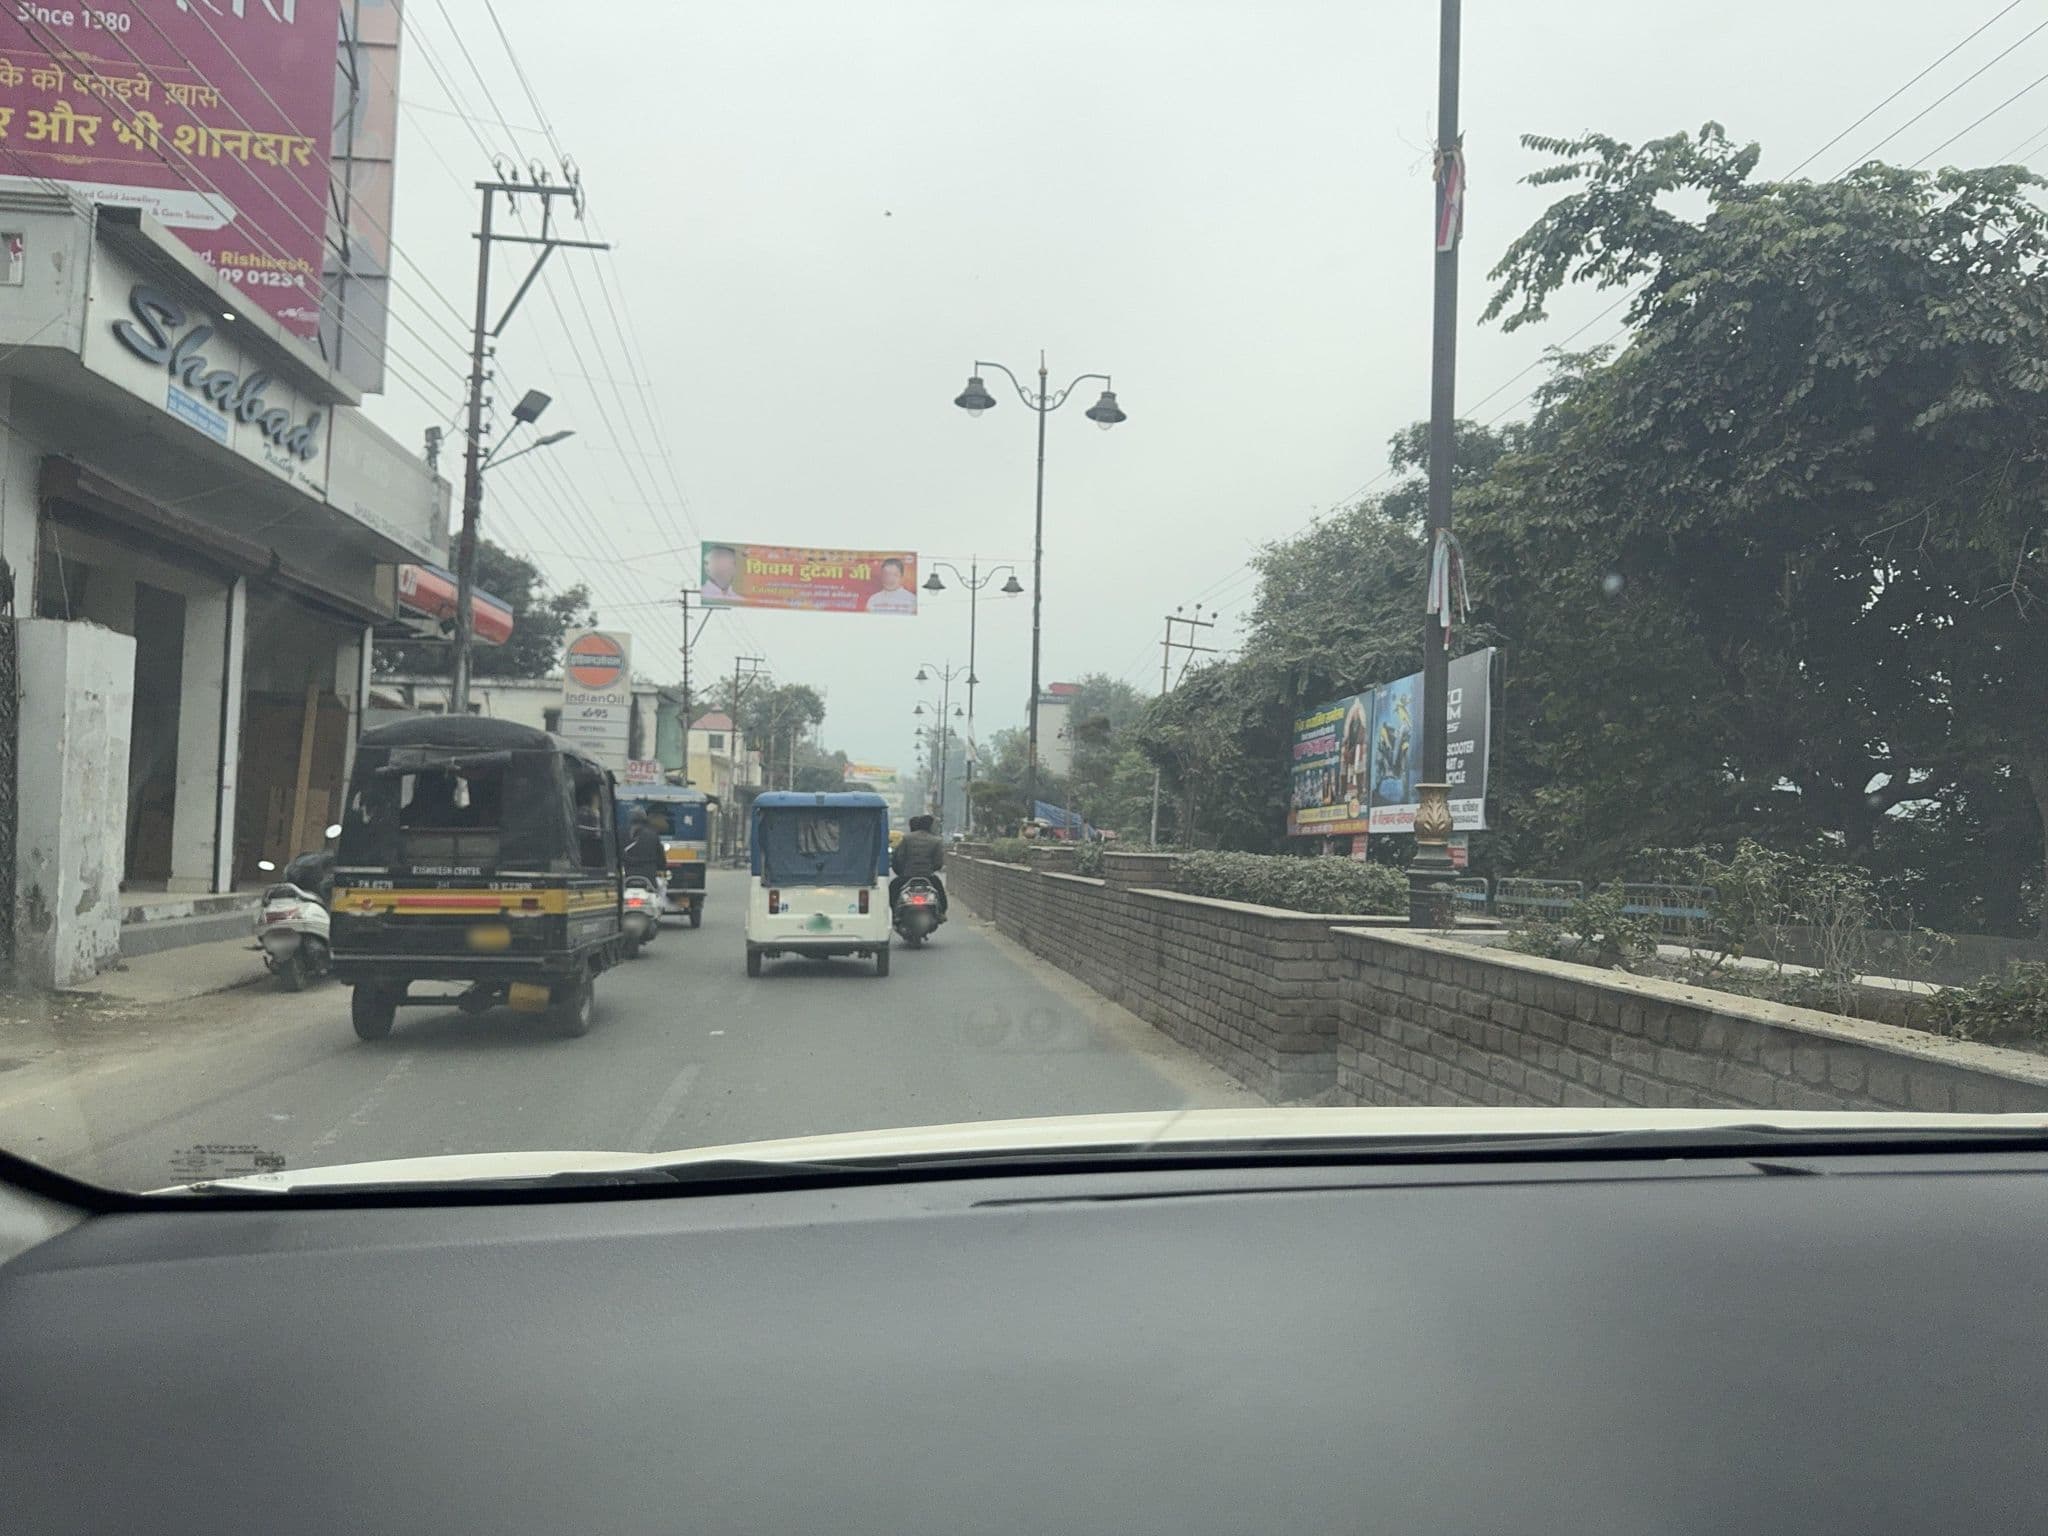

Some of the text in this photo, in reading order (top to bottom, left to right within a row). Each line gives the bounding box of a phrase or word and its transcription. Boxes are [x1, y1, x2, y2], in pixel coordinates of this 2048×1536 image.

[17, 2, 131, 32] Since 1980
[32, 63, 66, 94] को
[25, 100, 102, 146] और
[112, 111, 163, 152] भी
[173, 125, 317, 167] शानदार
[112, 284, 322, 460] Shabad
[566, 694, 625, 705] IndianOil
